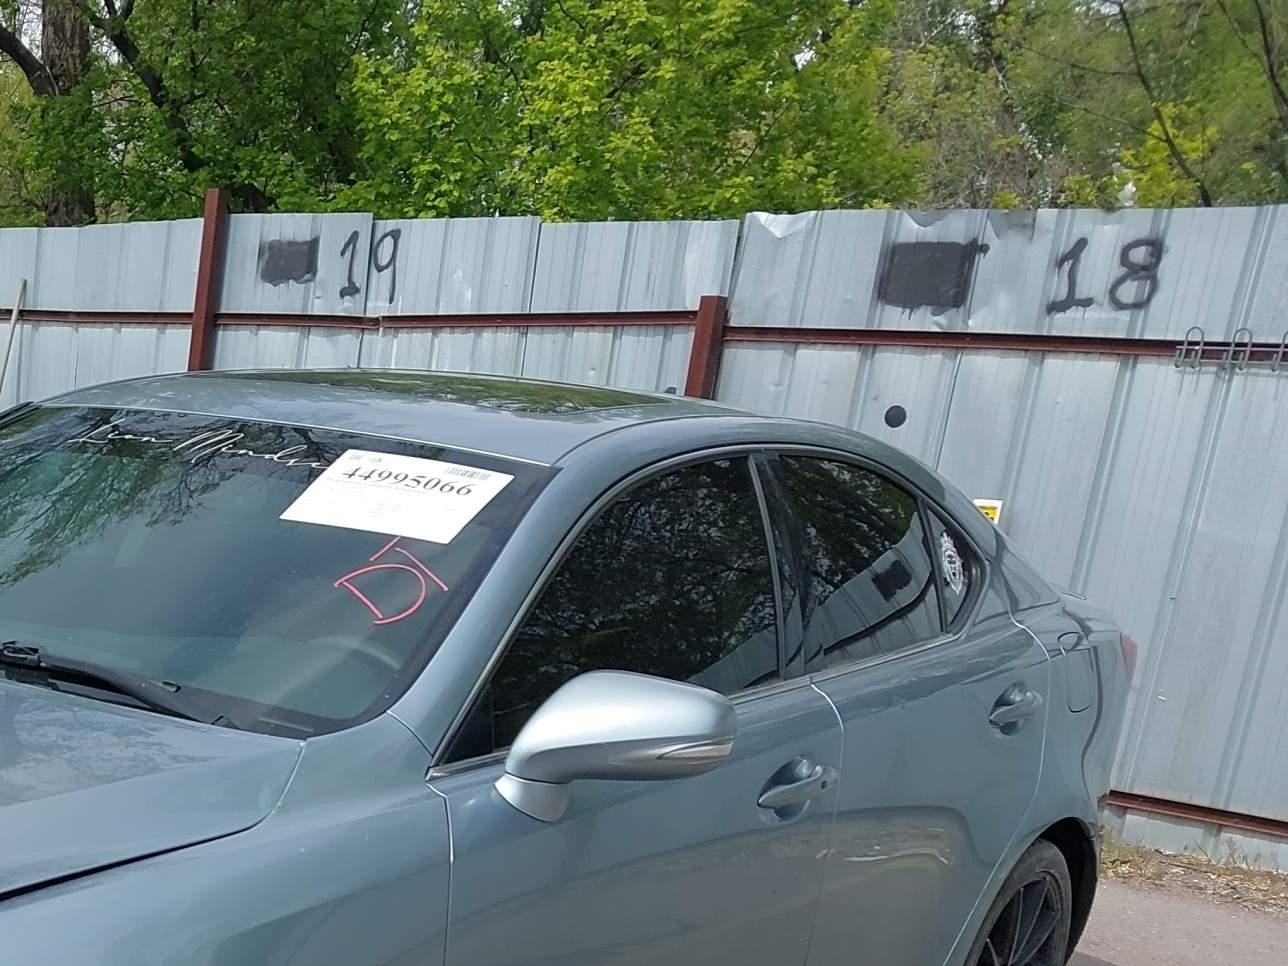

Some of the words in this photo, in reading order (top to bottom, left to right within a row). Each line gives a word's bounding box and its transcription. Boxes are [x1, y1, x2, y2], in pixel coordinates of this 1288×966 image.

[339, 228, 402, 304] 19
[1045, 236, 1167, 315] 18
[341, 464, 477, 497] 44995066
